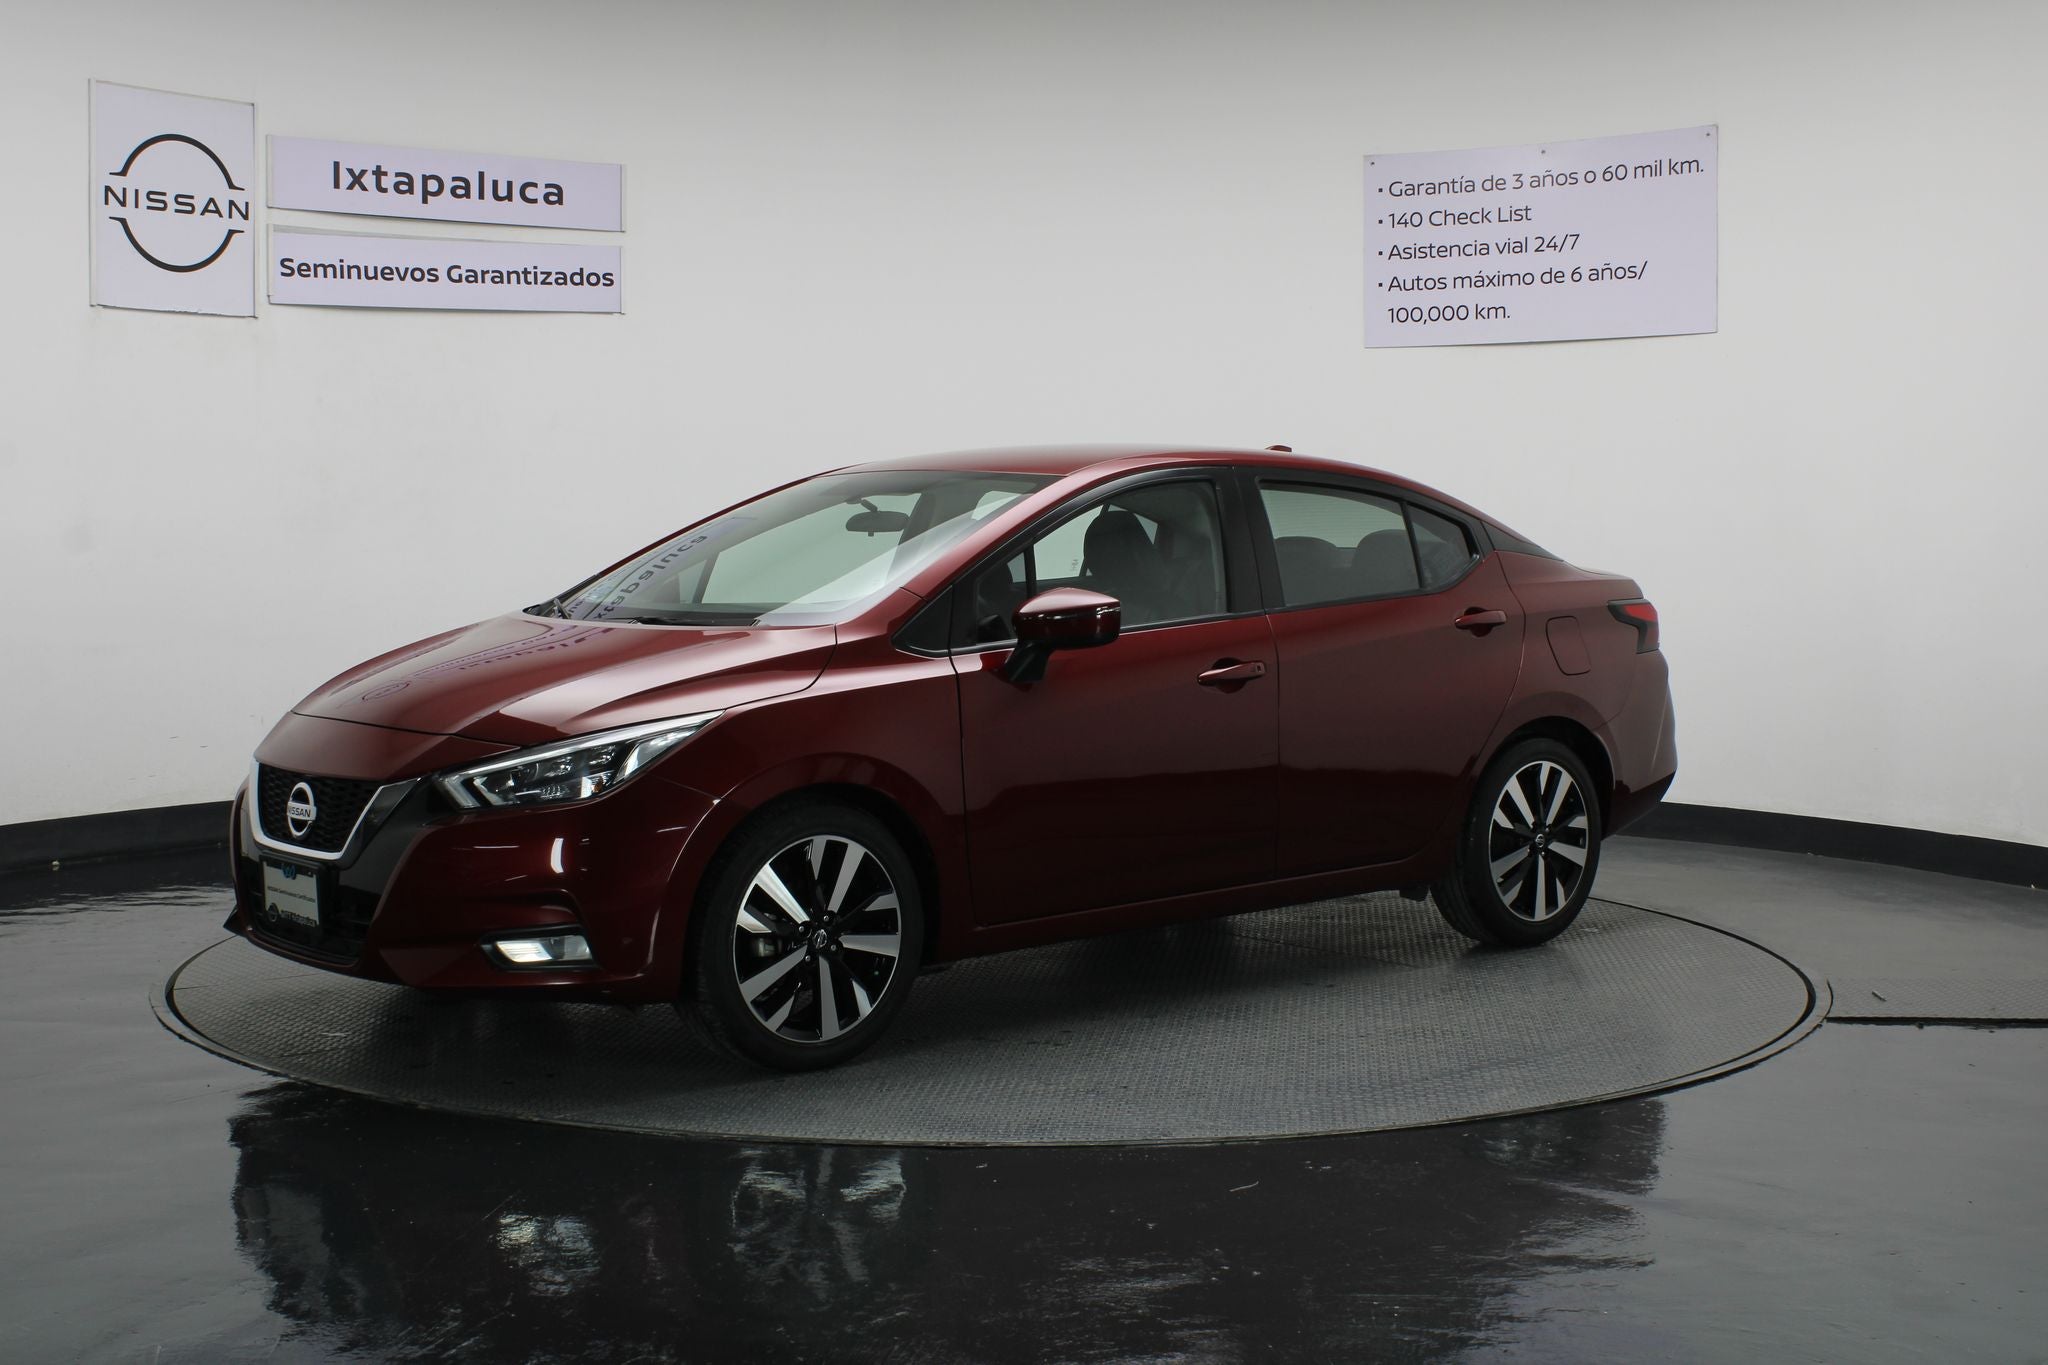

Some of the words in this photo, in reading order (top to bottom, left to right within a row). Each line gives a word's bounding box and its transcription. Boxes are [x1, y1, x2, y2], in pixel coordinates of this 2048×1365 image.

[333, 160, 564, 206] Ixtapaluca
[1388, 175, 1476, 198] Garantía
[1481, 174, 1507, 192] de
[1512, 173, 1525, 190] 3
[1529, 169, 1579, 189] años
[1583, 170, 1597, 184] o
[1602, 164, 1628, 182] 60
[1633, 159, 1663, 180] mil
[1668, 158, 1704, 176] km.
[104, 184, 250, 221] NISSAN
[1388, 211, 1423, 229] 140
[1428, 207, 1492, 227] Check
[1497, 205, 1532, 223] List
[1387, 239, 1490, 261] Asistencia
[1495, 236, 1528, 255] vial
[1534, 233, 1580, 253] 24/7
[279, 257, 440, 283] Seminuevos
[446, 264, 615, 288] Garantizados
[1387, 275, 1448, 292] Autos
[1453, 270, 1535, 289] máximo
[1540, 267, 1565, 285] de
[1570, 266, 1583, 283] 6
[1588, 260, 1648, 282] años/
[1387, 304, 1470, 325] 100,000
[1475, 303, 1511, 320] km.
